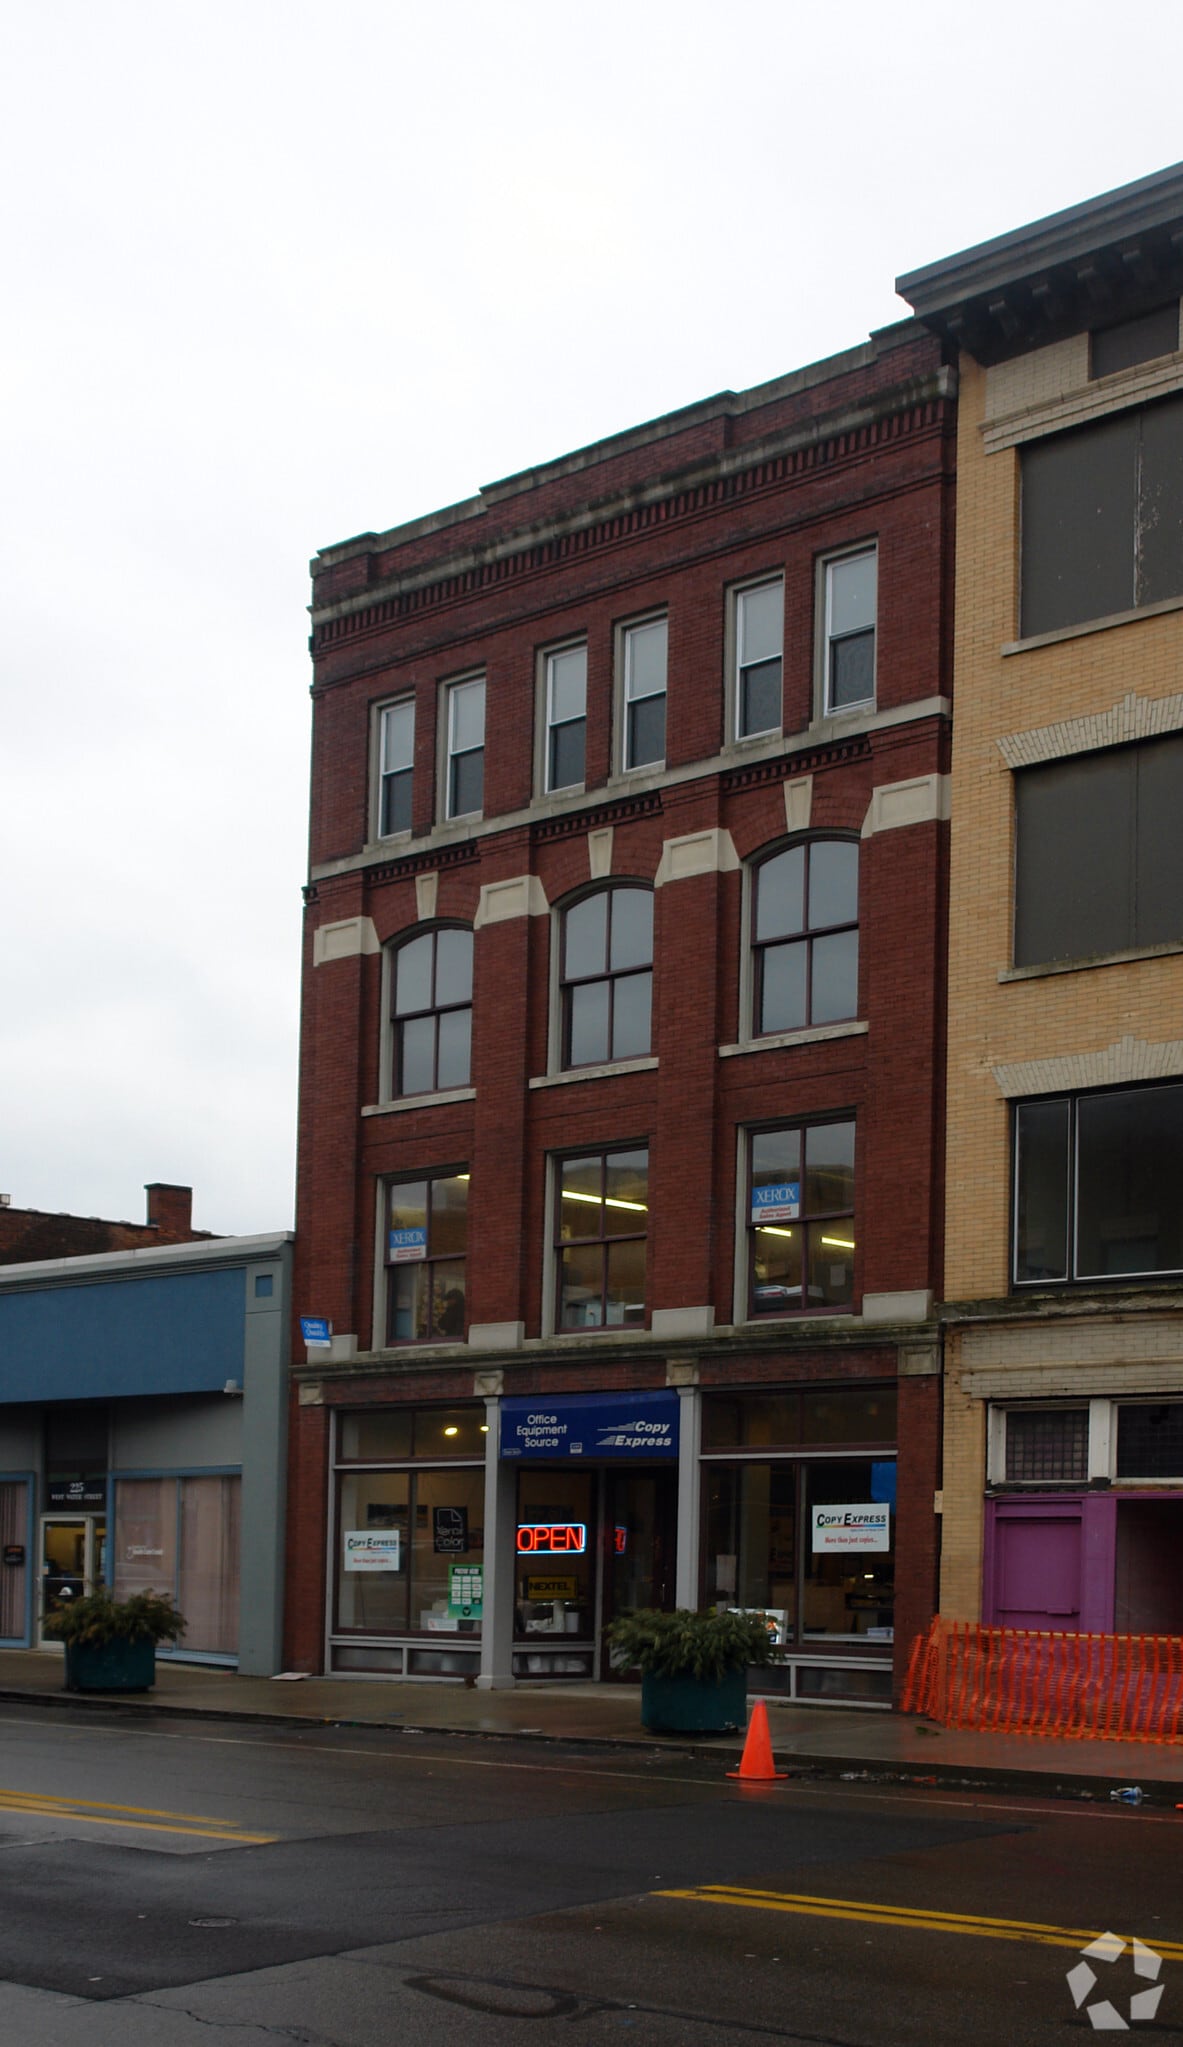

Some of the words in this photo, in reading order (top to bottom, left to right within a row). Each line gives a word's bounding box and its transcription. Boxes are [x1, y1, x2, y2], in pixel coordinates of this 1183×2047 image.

[757, 1188, 795, 1204] XEROX
[393, 1231, 424, 1244] XEROX
[527, 1414, 557, 1425] Office
[516, 1424, 567, 1438] Equipment
[635, 1420, 670, 1434] Copy
[524, 1437, 559, 1449] Source
[614, 1434, 672, 1448] Express
[69, 1482, 85, 1493] 225
[517, 1527, 582, 1551] OPEN
[528, 1582, 571, 1591] NEXTEL
